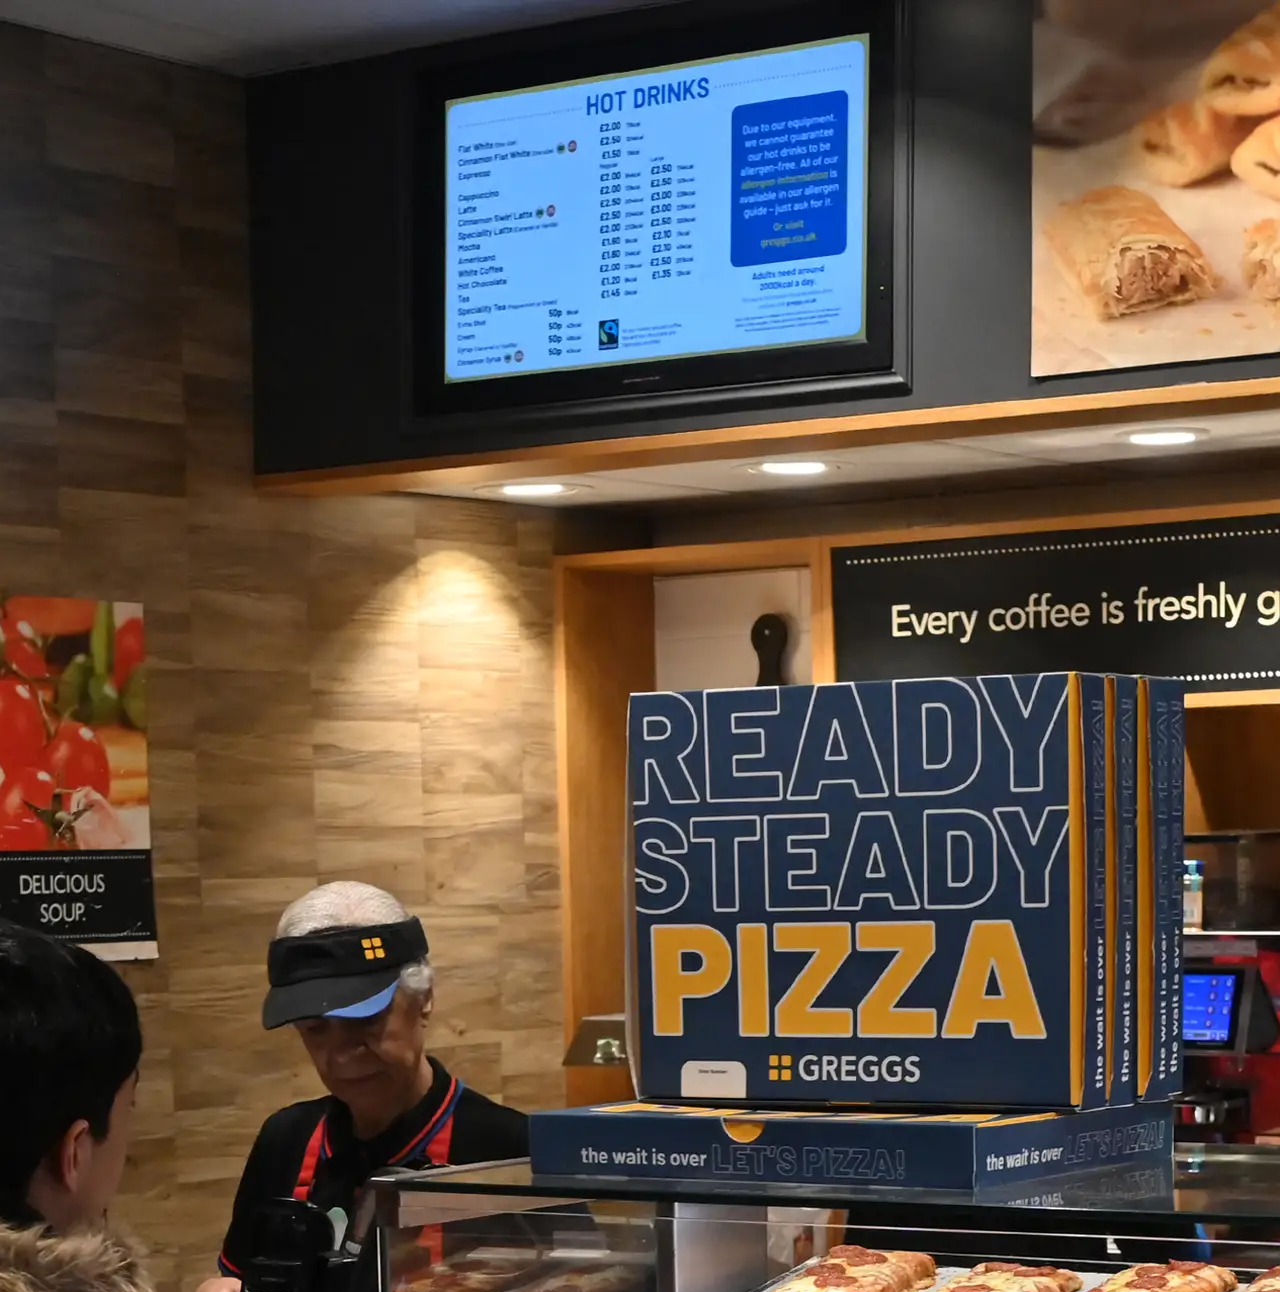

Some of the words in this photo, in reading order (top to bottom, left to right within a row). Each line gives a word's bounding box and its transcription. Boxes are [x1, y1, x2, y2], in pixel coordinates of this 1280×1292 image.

[586, 90, 626, 115] HOT
[634, 77, 710, 110] DRINKS
[891, 604, 978, 644] Every
[988, 593, 1090, 630] coffee
[1101, 592, 1124, 625] is
[1134, 581, 1247, 628] freshly
[633, 672, 1069, 806] READY
[633, 805, 1069, 915] STEADY
[19, 873, 105, 896] DELICIOUS
[40, 902, 86, 923] SOUP.
[649, 919, 1047, 1040] PIZZA
[797, 1053, 921, 1084] GREGGS
[581, 1147, 608, 1164] the
[612, 1148, 648, 1165] wait
[652, 1149, 666, 1166] is
[670, 1152, 706, 1166] over
[712, 1144, 797, 1176] LET'S
[803, 1147, 905, 1180] PIZZA!
[986, 1153, 1004, 1171] the
[1006, 1149, 1028, 1169] wait
[1030, 1147, 1039, 1164] is
[1041, 1147, 1064, 1162] over
[1065, 1129, 1112, 1164] LET'S
[1112, 1121, 1166, 1155] PIZZA!
